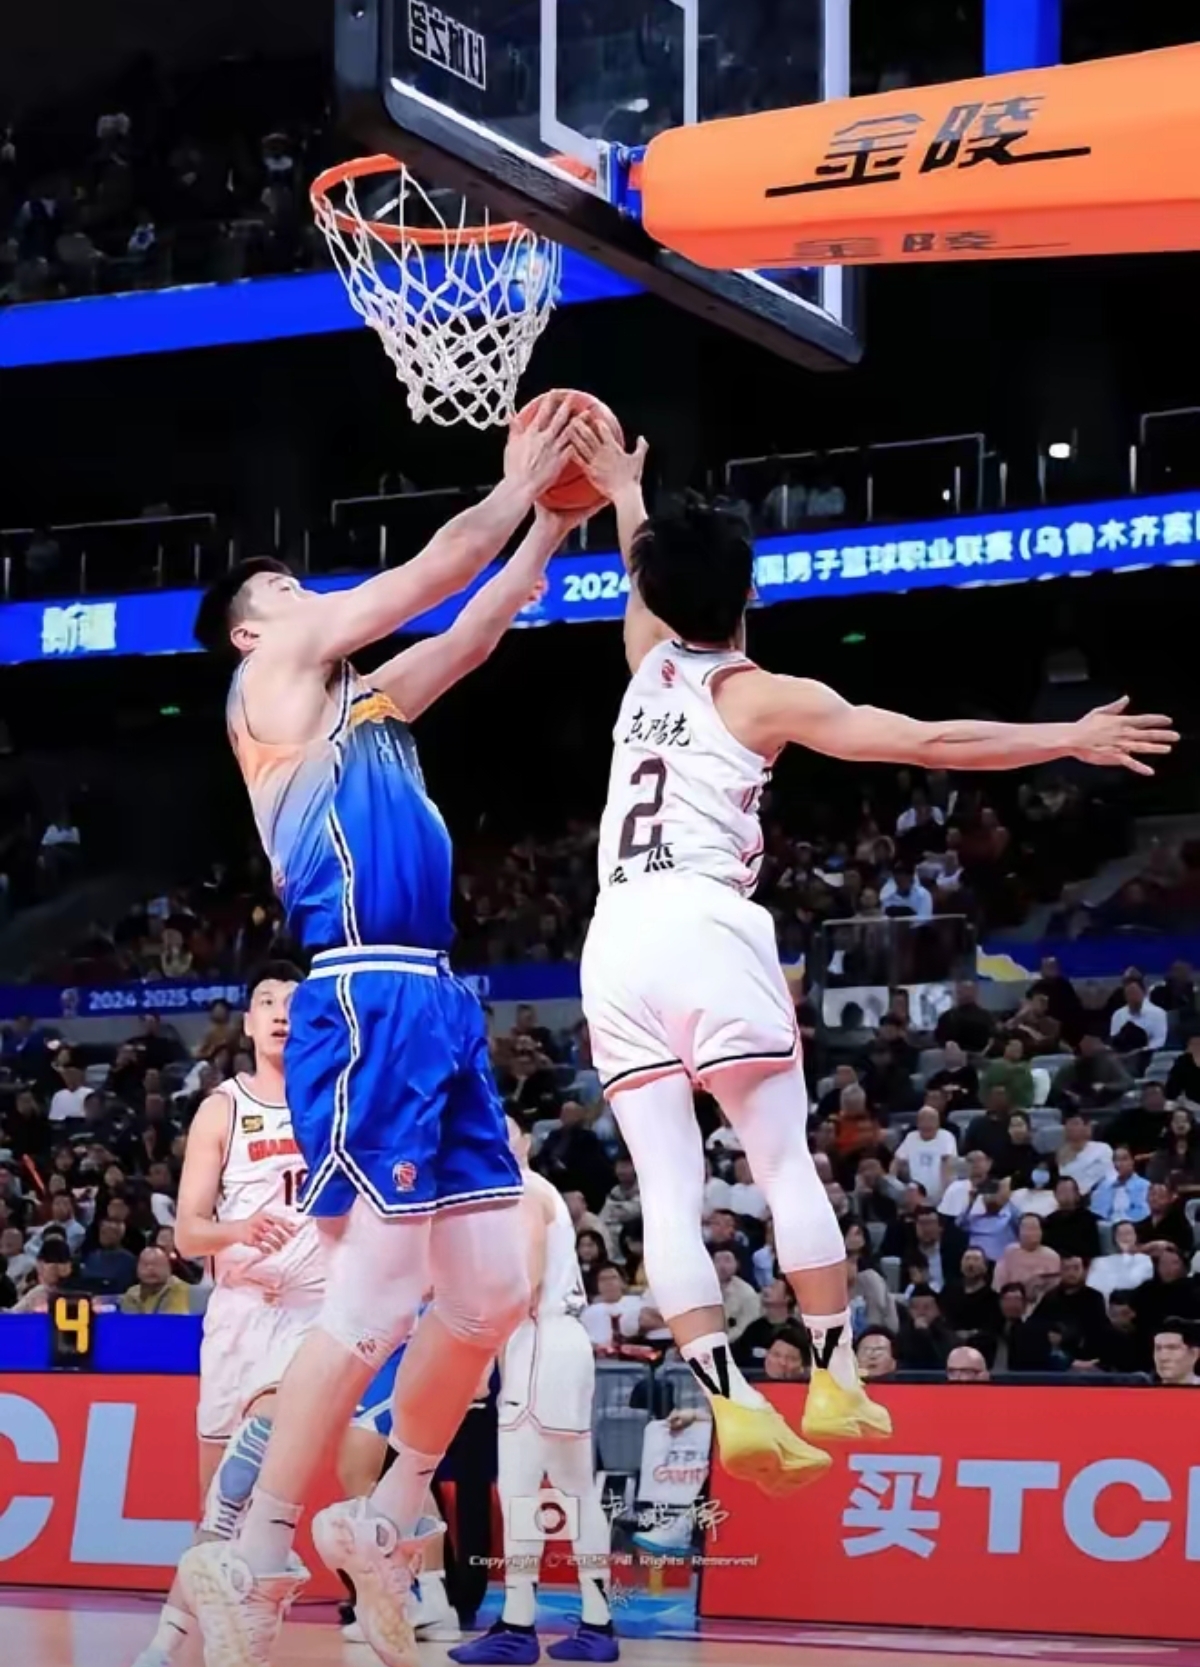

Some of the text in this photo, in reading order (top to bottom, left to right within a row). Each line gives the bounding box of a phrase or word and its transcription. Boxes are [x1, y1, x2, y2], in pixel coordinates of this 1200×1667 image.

[765, 95, 1092, 198] 金陵
[618, 756, 667, 860] 2
[55, 1297, 90, 1353] 4
[842, 1453, 1200, 1562] 买TC
